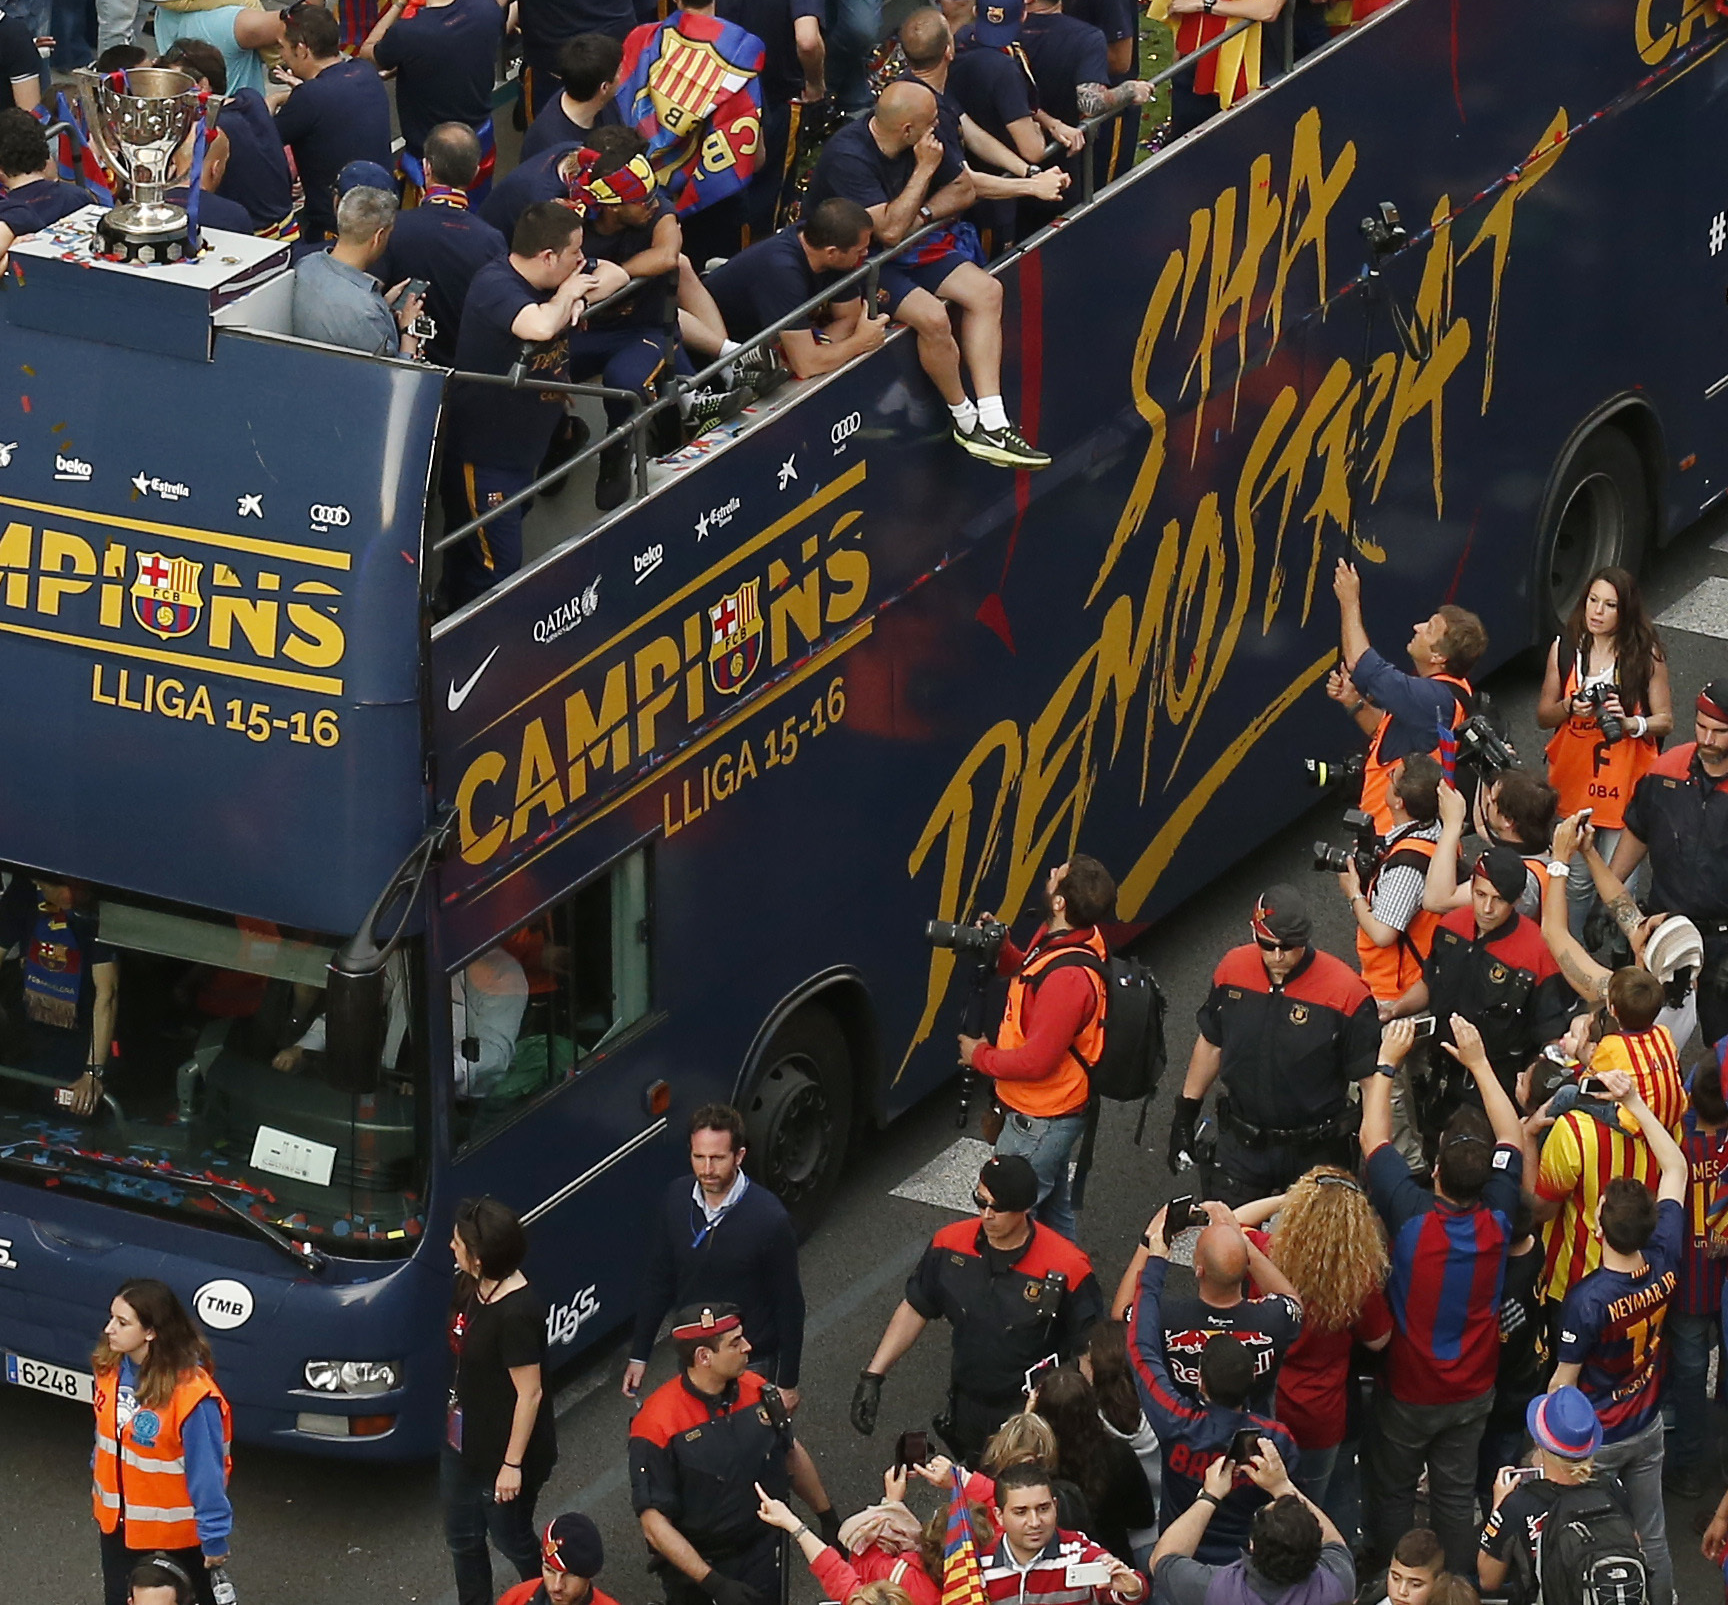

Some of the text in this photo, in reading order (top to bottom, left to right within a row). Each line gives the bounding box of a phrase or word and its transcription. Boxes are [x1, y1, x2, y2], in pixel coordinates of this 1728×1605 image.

[55, 453, 92, 475] beko
[634, 543, 664, 573] beko
[892, 106, 1568, 1086] DEMOSTRAT
[532, 595, 582, 643] QATAR
[92, 663, 340, 748] LLIGA 15-16
[661, 676, 847, 840] LLIGA 15-16
[1588, 782, 1620, 800] 084
[206, 1296, 244, 1316] TMB
[1607, 1270, 1678, 1324] NEYMAR JR
[22, 1361, 79, 1397] 6248
